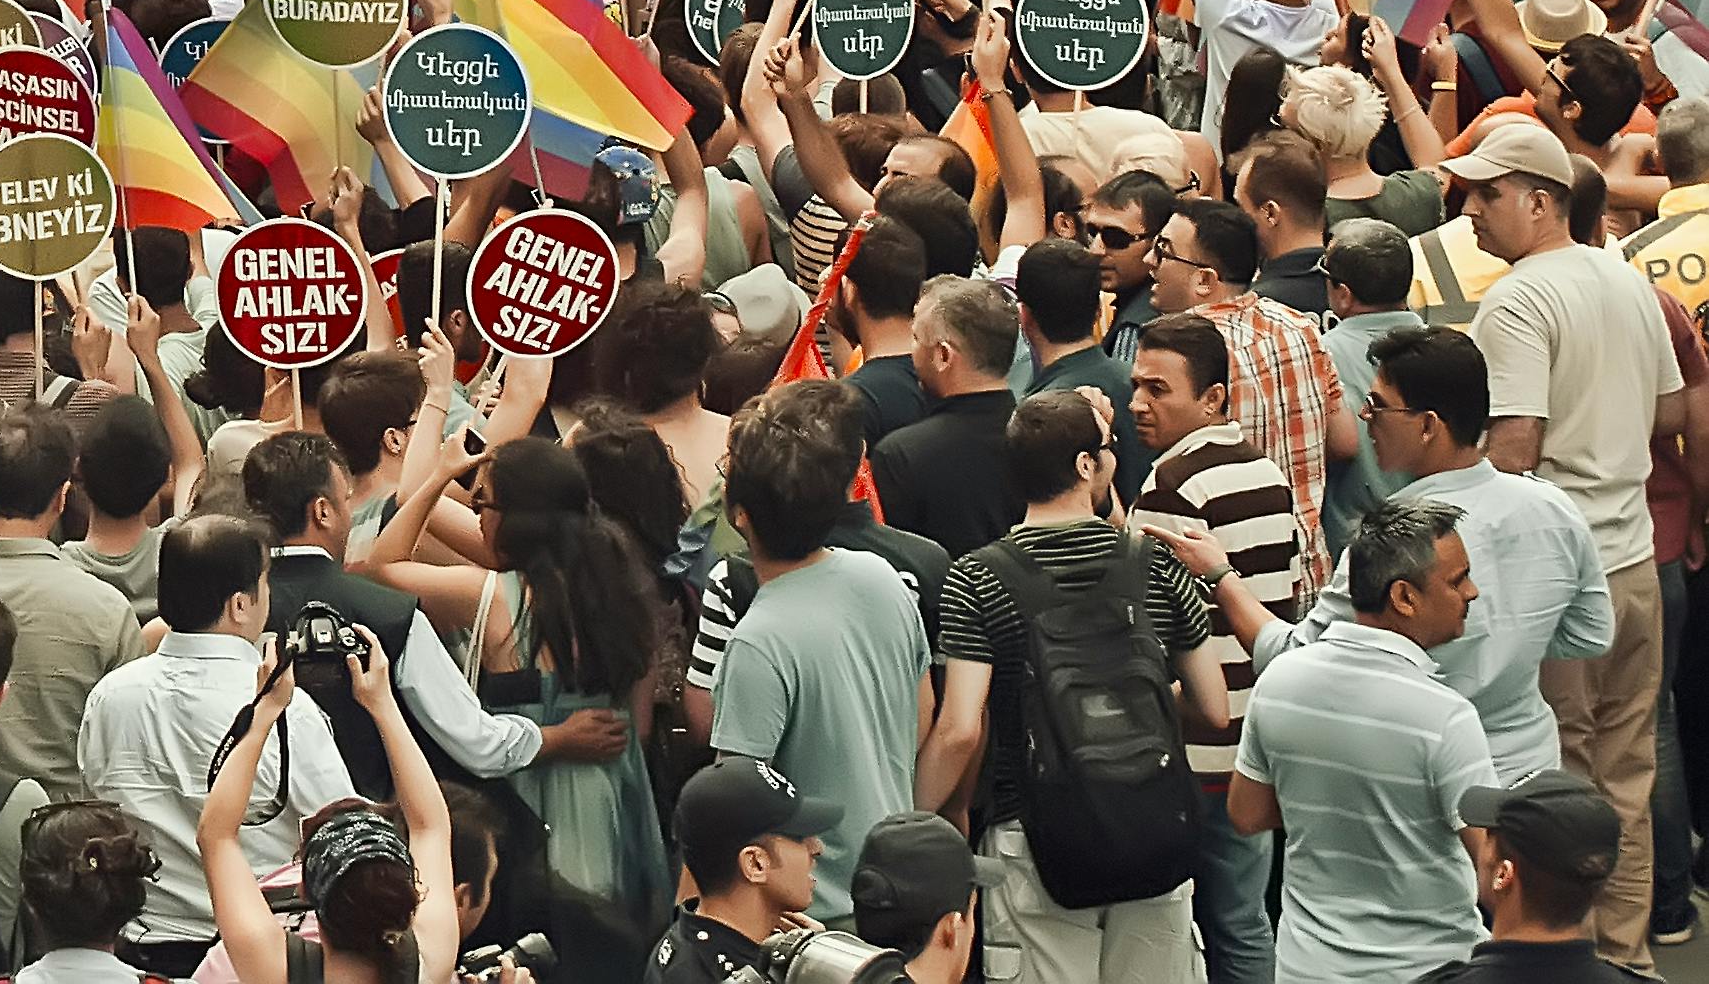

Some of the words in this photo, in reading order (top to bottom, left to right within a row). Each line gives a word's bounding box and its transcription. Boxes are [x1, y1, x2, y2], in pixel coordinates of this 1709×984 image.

[0, 22, 23, 47] Kİ
[842, 29, 885, 62] սեր
[416, 52, 500, 86] Կեցցե
[1055, 38, 1106, 71] սեր
[387, 88, 526, 117] միասեռական
[425, 119, 483, 157] սեր
[66, 167, 94, 198] Kİ
[234, 246, 346, 282] GENEL
[504, 225, 608, 291] GENEL
[233, 283, 358, 319] AHLAK-
[482, 261, 602, 326] AHLAK-
[260, 321, 328, 356] SIZ!
[492, 304, 563, 353] SIZ!
